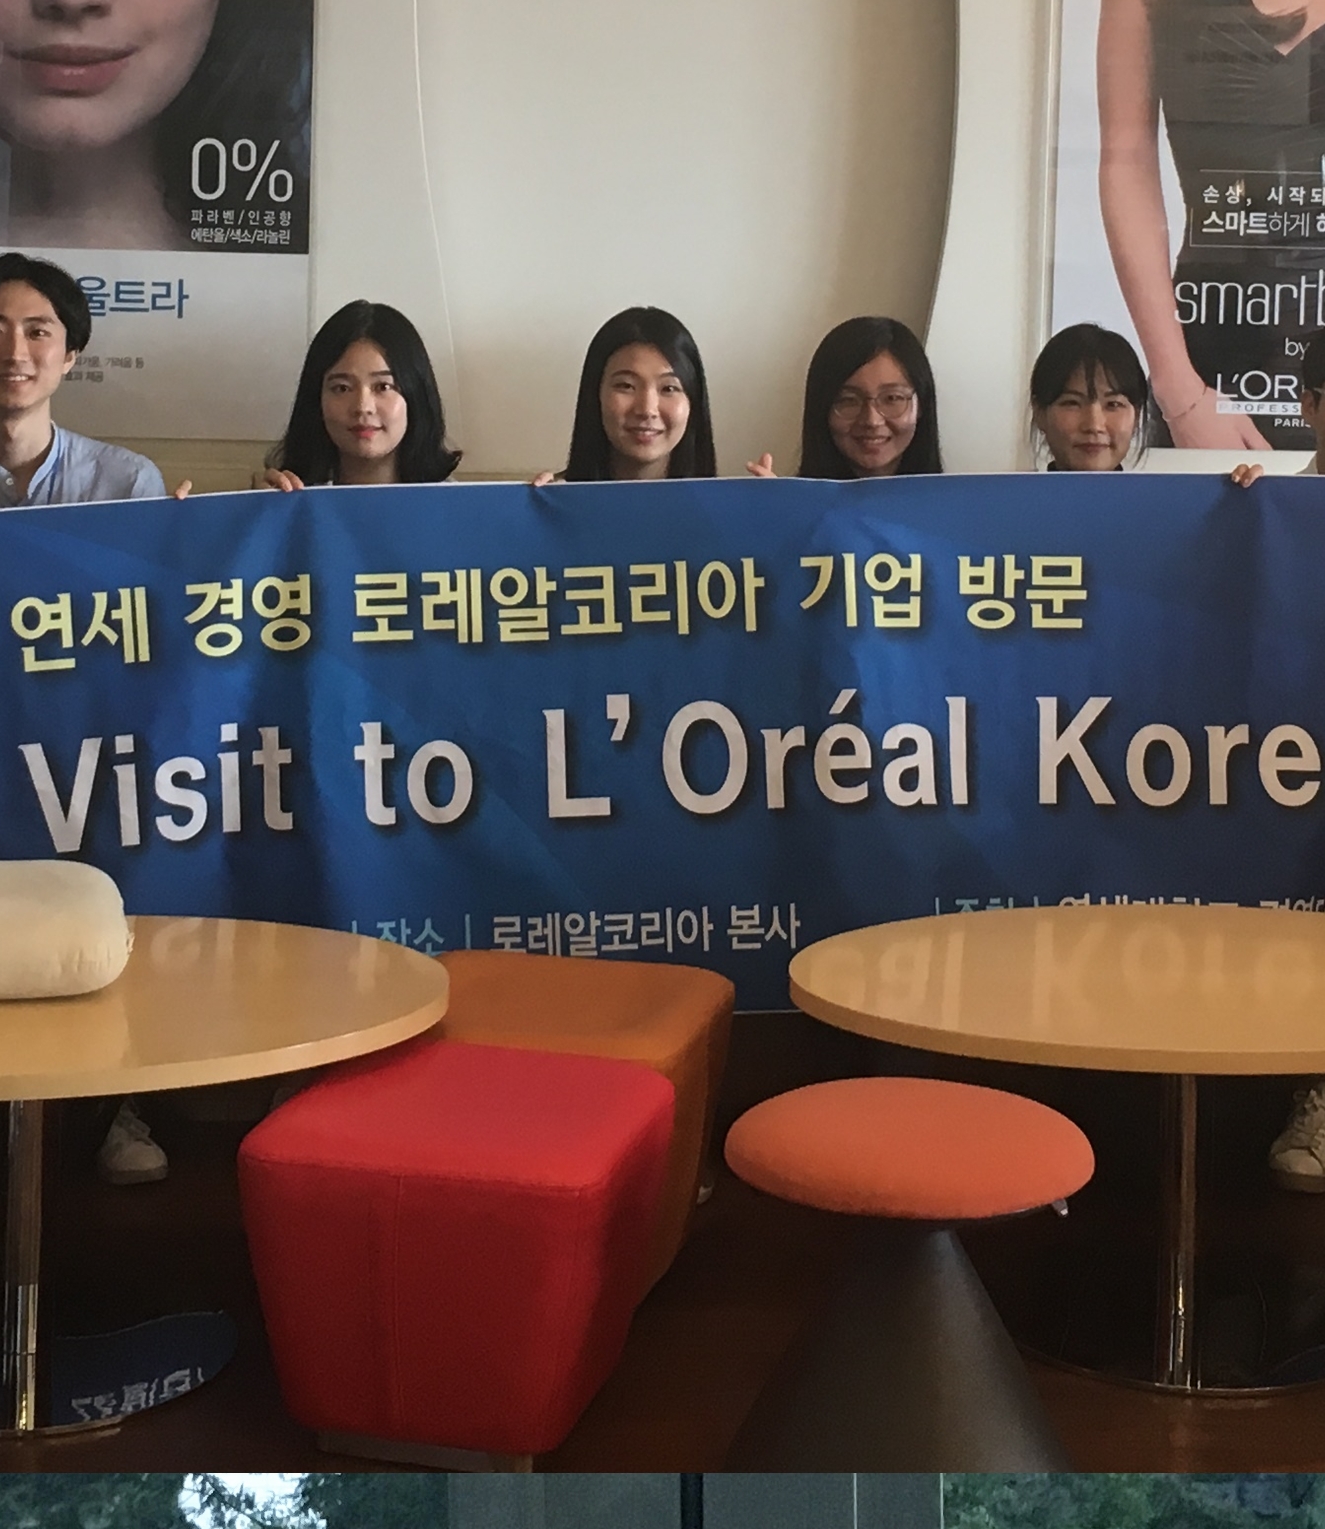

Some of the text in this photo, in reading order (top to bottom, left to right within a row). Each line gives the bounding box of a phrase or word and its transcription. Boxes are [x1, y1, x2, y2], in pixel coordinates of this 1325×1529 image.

[192, 138, 293, 202] 0%
[1202, 184, 1252, 206] 손상,
[1201, 210, 1310, 237] 스마트하게
[1284, 337, 1311, 361] by
[1216, 370, 1305, 400] L'OR
[1217, 403, 1301, 413] PROFESS
[1274, 418, 1312, 428] PARI
[9, 552, 1088, 674] 연세 경영 로레알코리아 기업 방문
[18, 721, 296, 854] Visit
[353, 720, 473, 827] to
[491, 905, 714, 957] 로레알코리아
[726, 903, 801, 950] 본사
